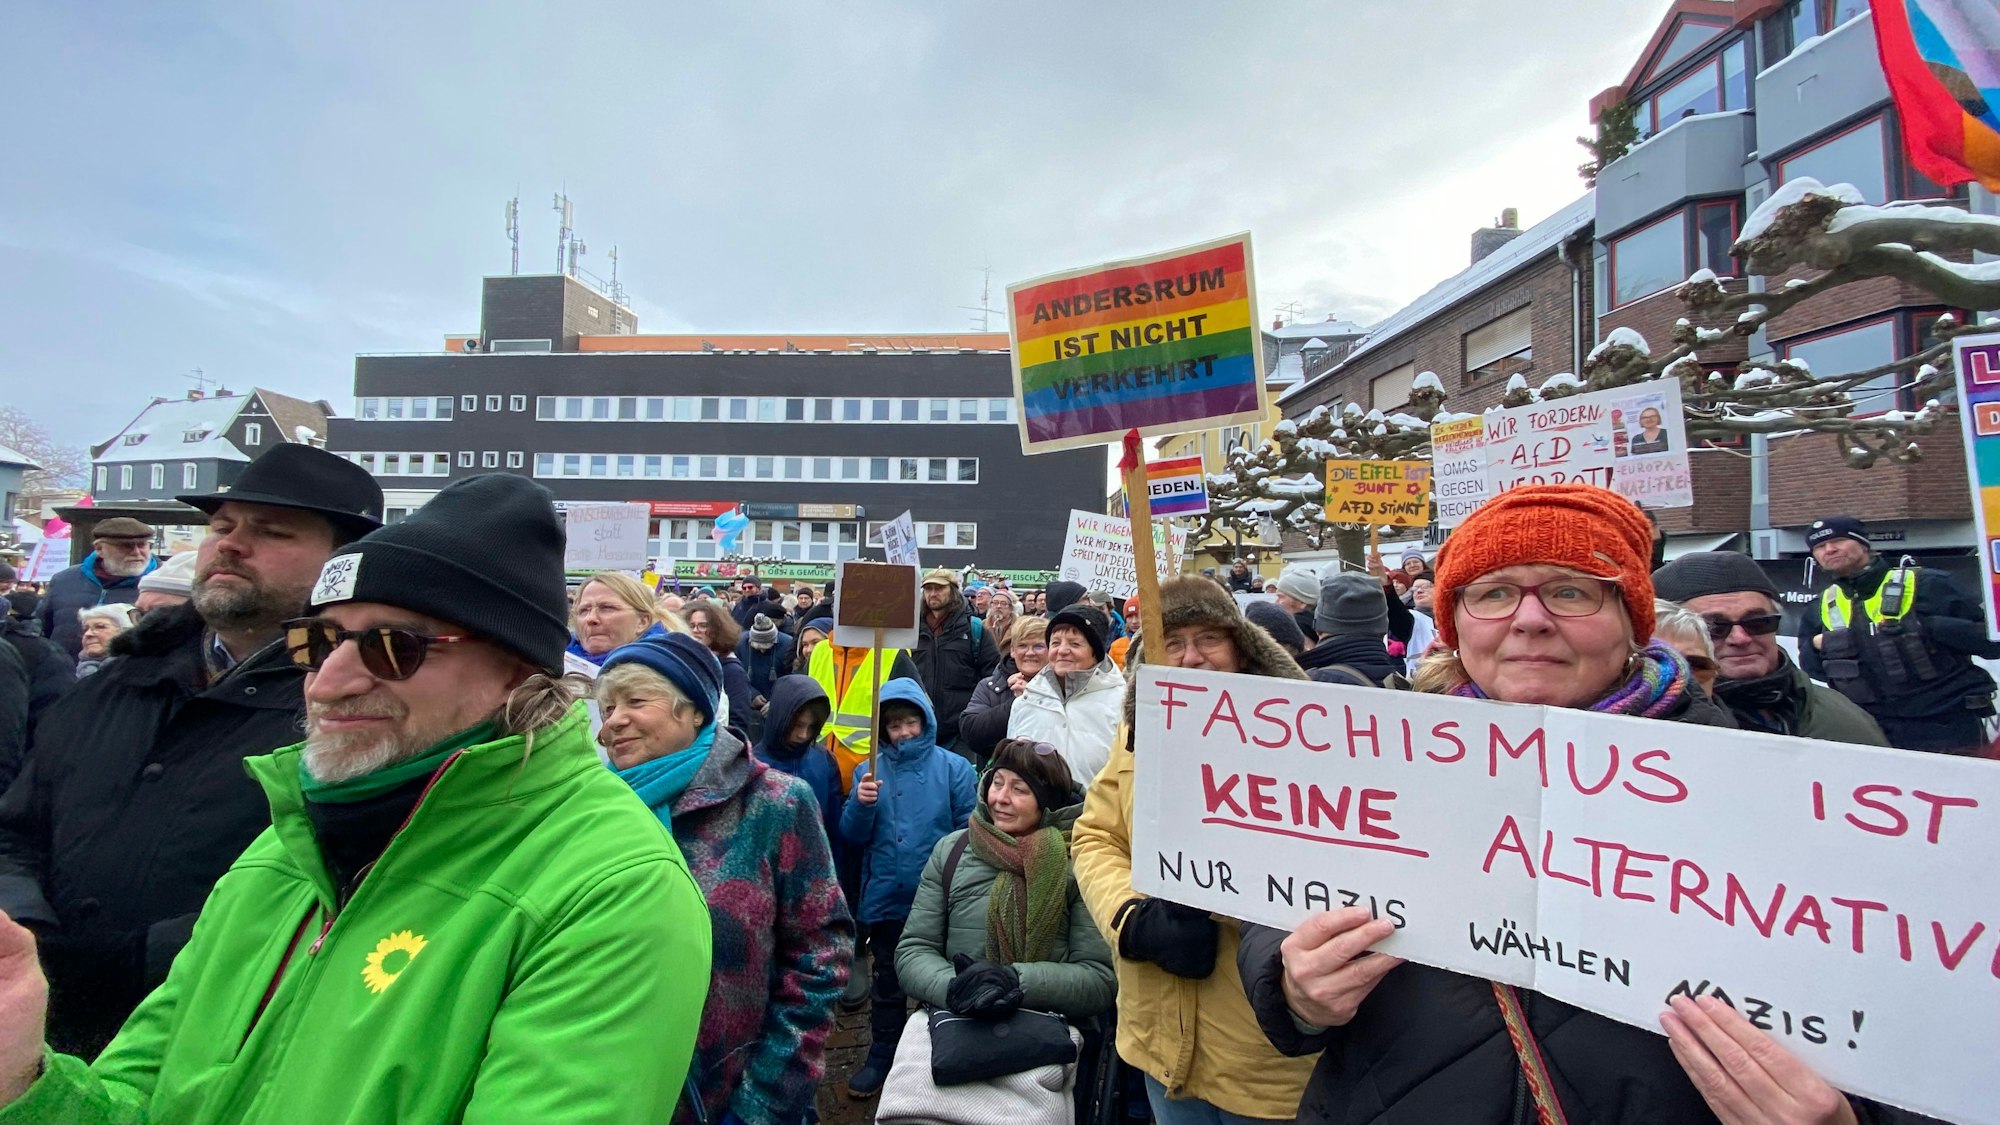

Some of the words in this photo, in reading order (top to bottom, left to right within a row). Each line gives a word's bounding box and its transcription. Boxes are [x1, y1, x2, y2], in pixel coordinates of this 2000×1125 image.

[1032, 266, 1225, 324] ANDERSRUM
[1054, 333, 1099, 359] IST
[1110, 314, 1208, 349] NICHT
[1053, 354, 1218, 399] VERKEHRT
[1970, 350, 2000, 385] L
[1528, 404, 1601, 429] FORDERN
[1511, 436, 1571, 467] AfD
[1443, 459, 1478, 476] OMAS
[1148, 480, 1200, 496] IEDEN.
[1353, 481, 1399, 495] BUNT
[1441, 478, 1484, 496] GEGEN
[1076, 534, 1094, 547] WER
[1108, 541, 1122, 551] DEM
[1809, 528, 1834, 541] POLIZEI
[1003, 572, 1037, 581] LEISCH
[1155, 680, 1688, 804] FASCHISMUS
[1812, 781, 1979, 845] IST
[1201, 763, 1401, 840] KEINE
[1482, 814, 2000, 980] ALTERNATIV
[1158, 851, 1240, 895] NUR
[1267, 873, 1407, 930] NAZIS
[1469, 917, 1630, 987] WÄHLEN
